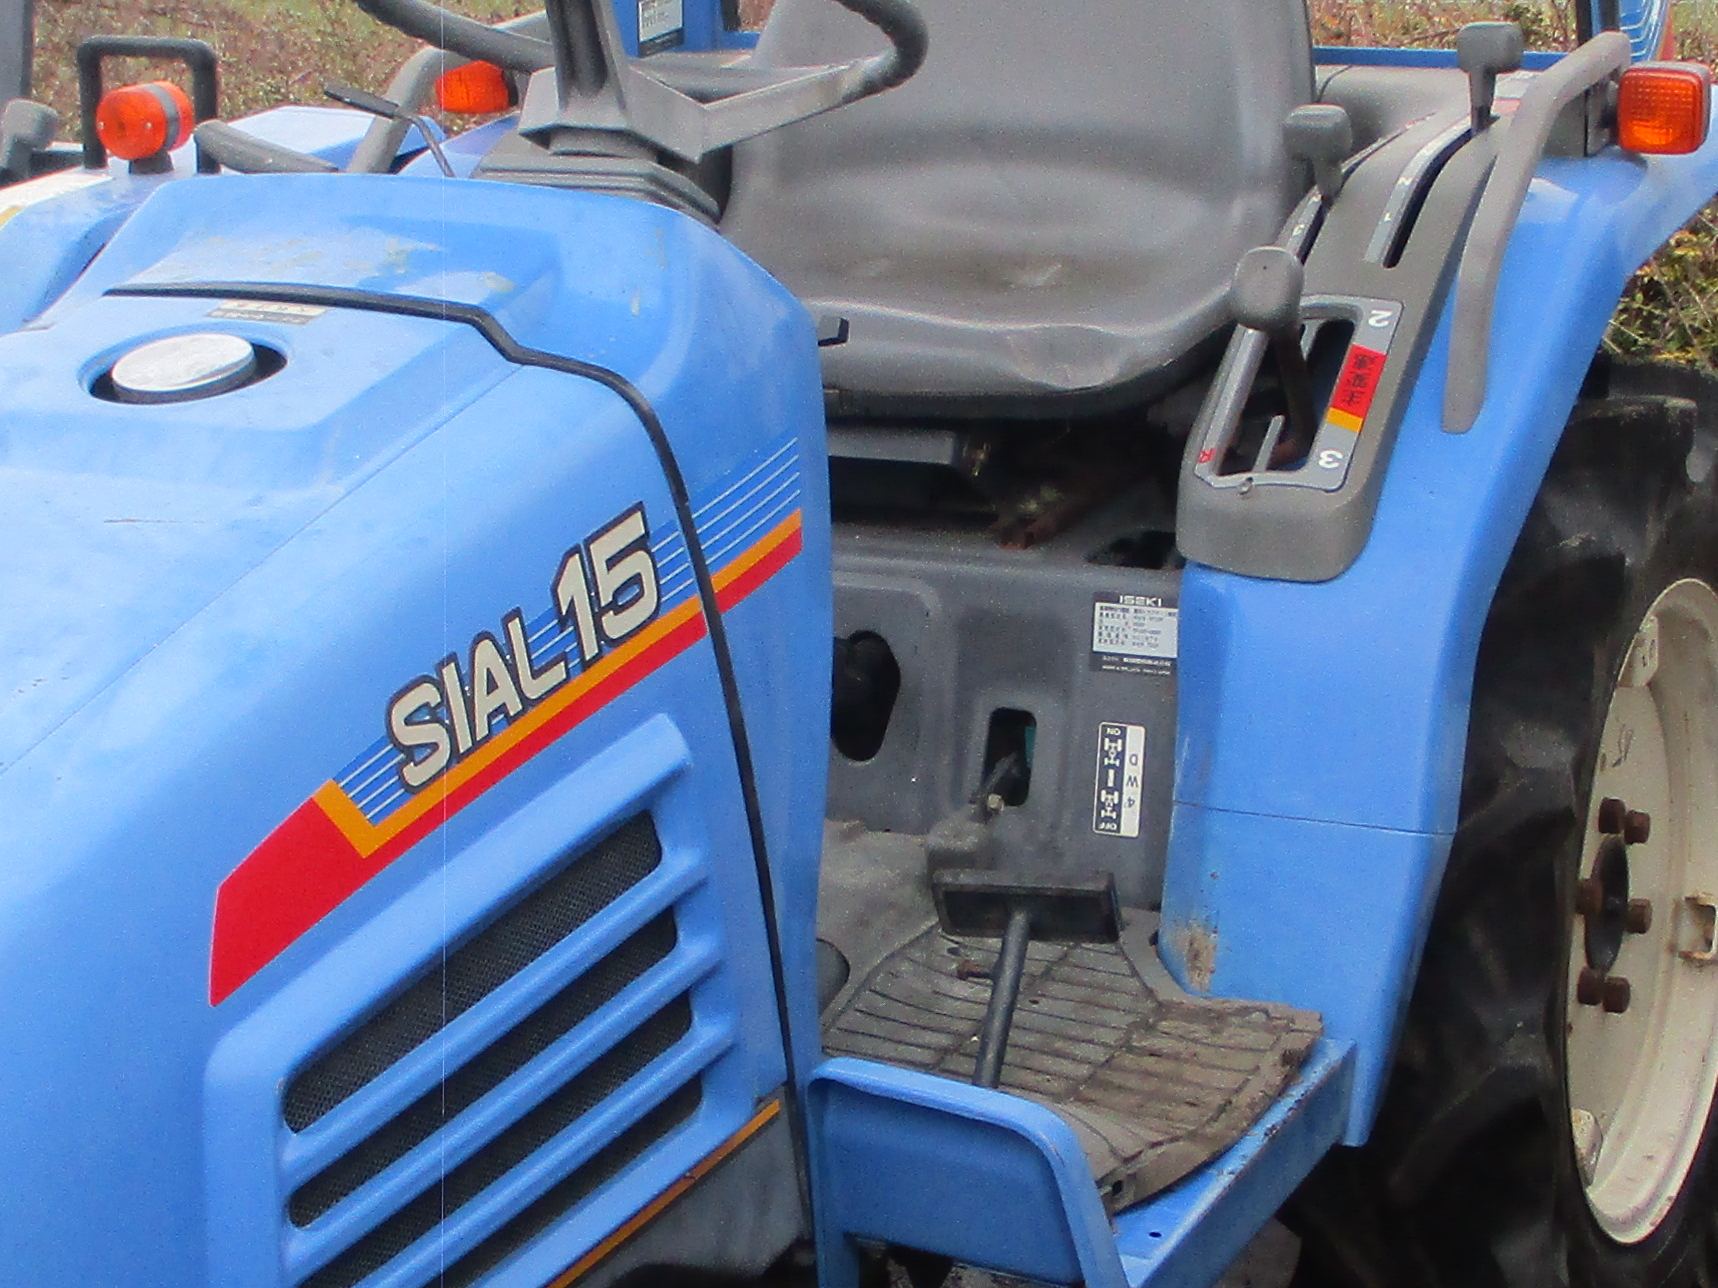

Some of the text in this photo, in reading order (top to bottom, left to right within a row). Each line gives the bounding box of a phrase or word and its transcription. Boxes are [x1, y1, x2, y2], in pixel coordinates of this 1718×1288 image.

[1367, 309, 1394, 328] 2
[1197, 447, 1217, 464] R
[1318, 449, 1344, 469] 3
[1118, 594, 1163, 608] ISEKI
[1098, 821, 1118, 831] OFF
